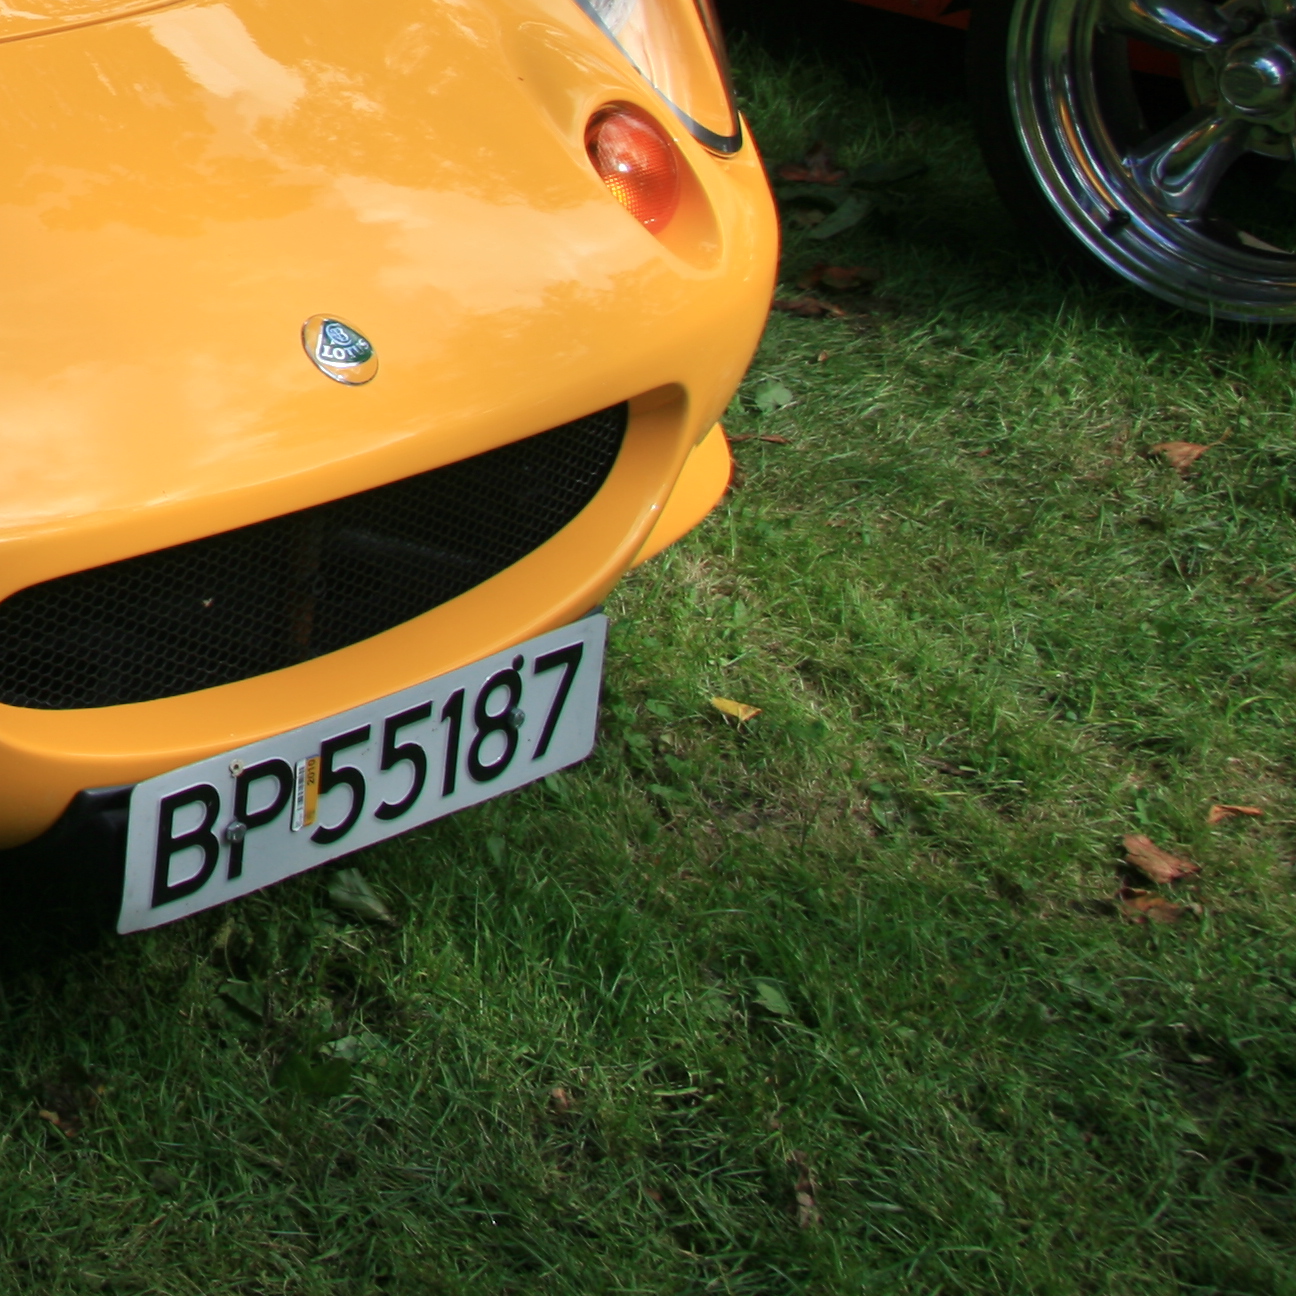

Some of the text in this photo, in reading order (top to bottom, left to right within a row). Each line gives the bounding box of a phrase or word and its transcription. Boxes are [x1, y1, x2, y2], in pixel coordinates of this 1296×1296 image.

[322, 338, 369, 360] LOTUS
[151, 641, 584, 908] BP 55187
[307, 759, 316, 786] 2010
